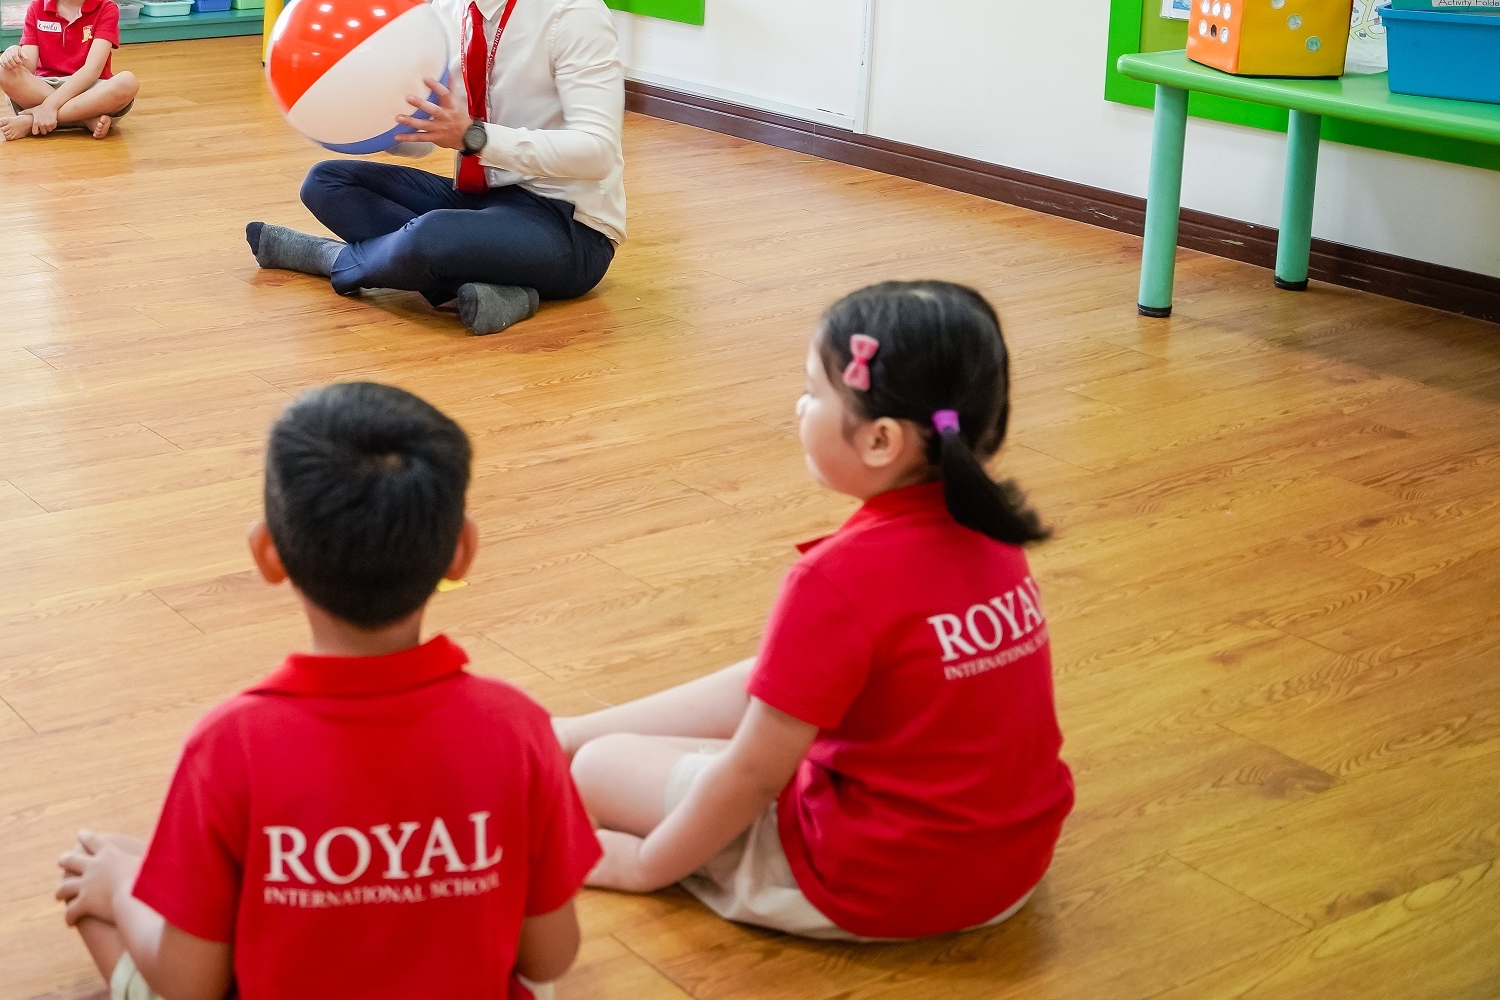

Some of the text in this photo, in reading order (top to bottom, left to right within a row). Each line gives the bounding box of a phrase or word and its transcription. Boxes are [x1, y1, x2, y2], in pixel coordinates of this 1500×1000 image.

[263, 810, 503, 884] ROYAL
[263, 871, 501, 908] INTERNATIONAL SCHOOL
